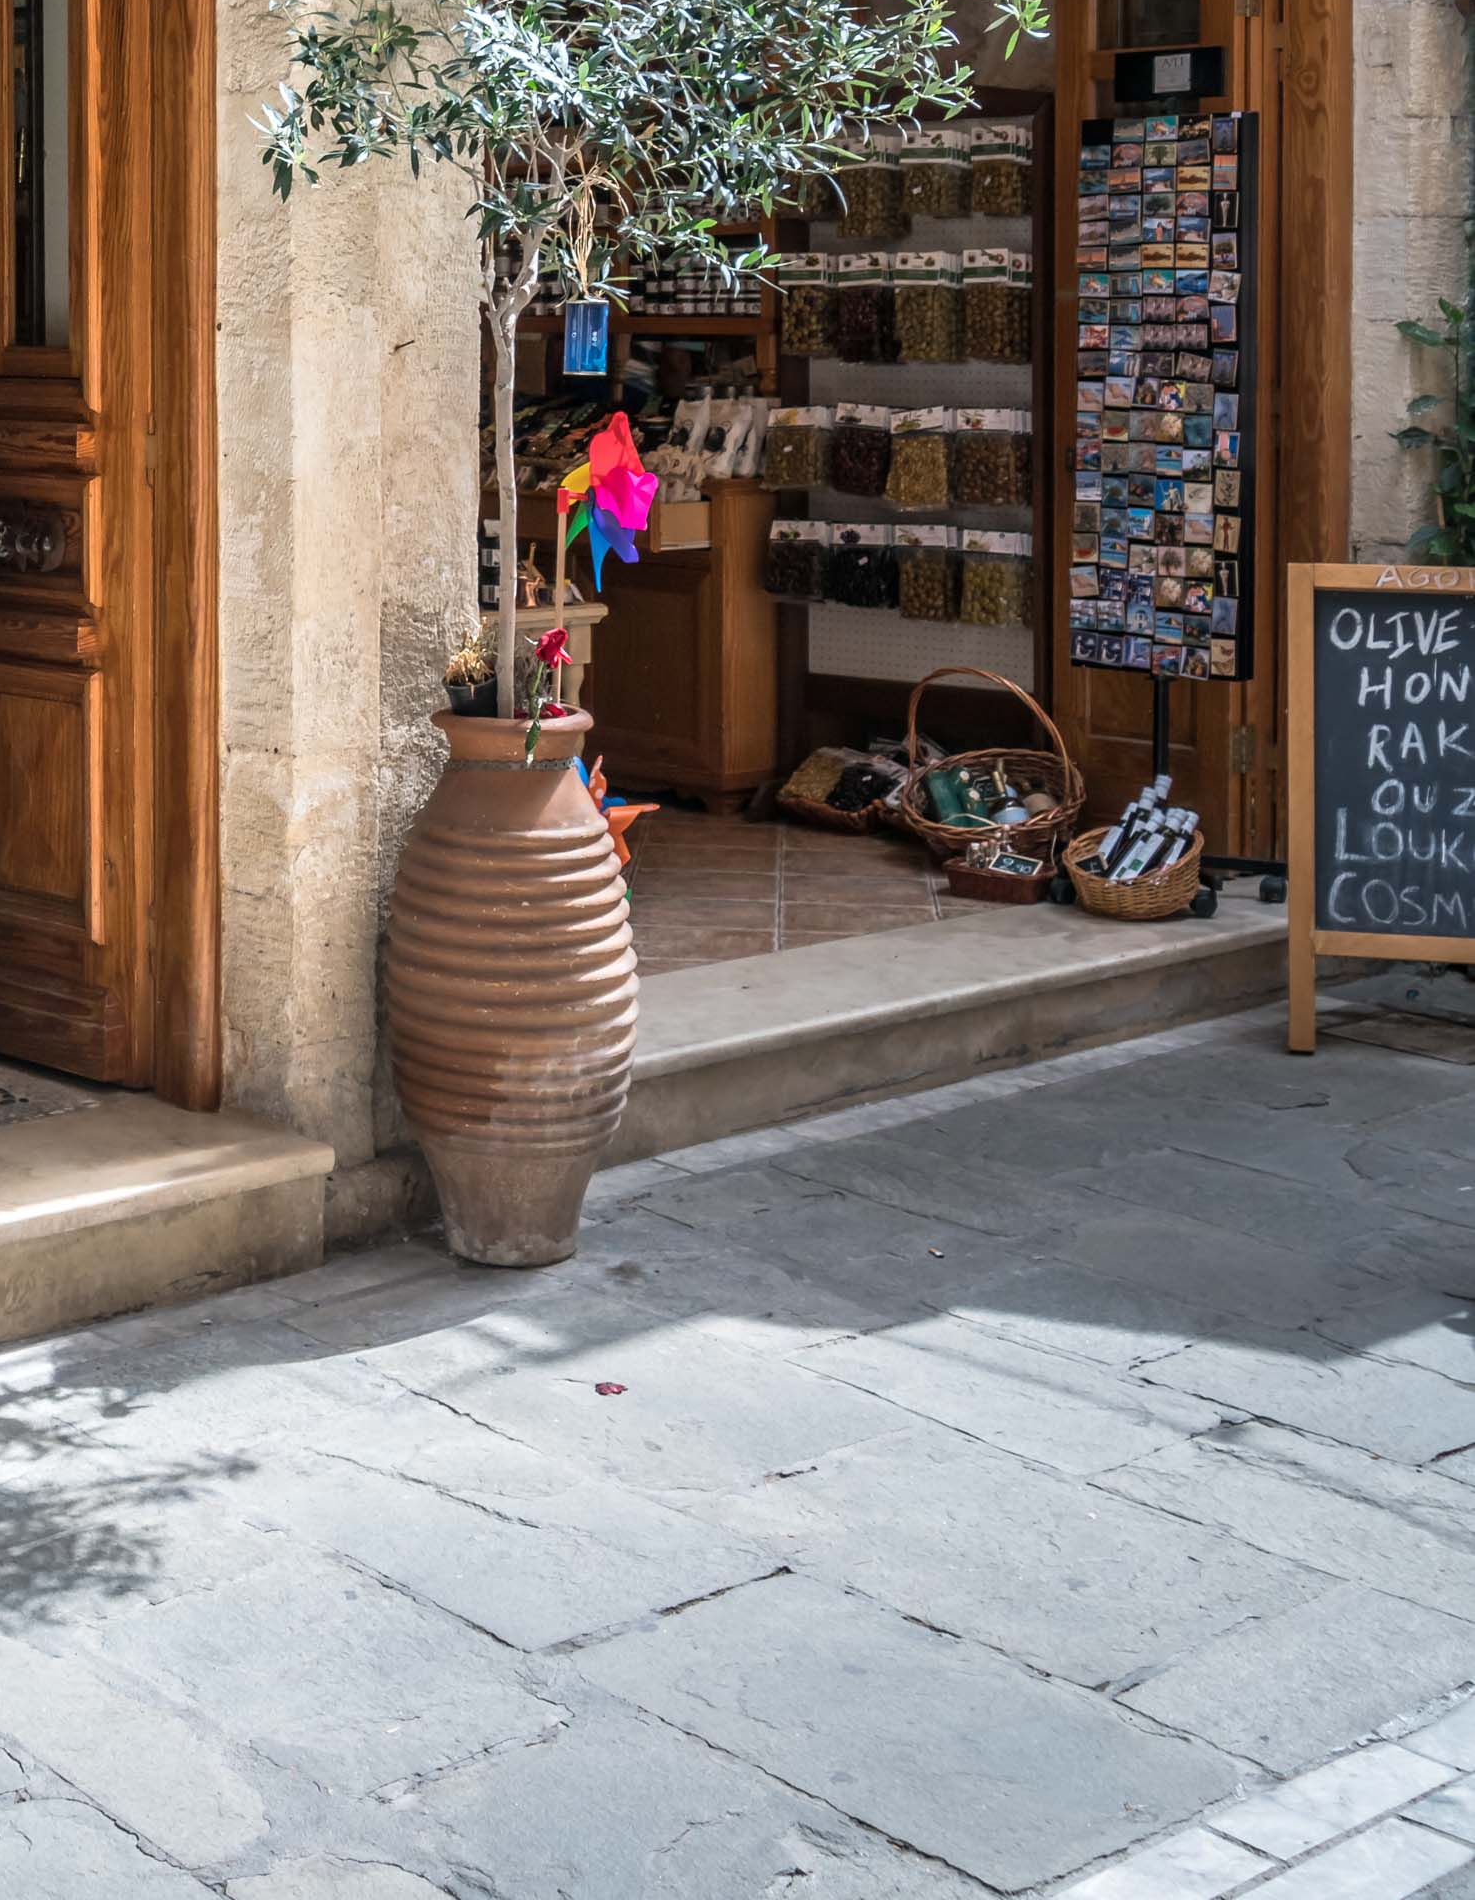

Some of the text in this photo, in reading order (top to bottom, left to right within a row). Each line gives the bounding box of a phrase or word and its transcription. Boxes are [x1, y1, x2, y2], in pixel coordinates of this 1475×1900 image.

[1330, 607, 1464, 659] OLIVE
[1357, 665, 1470, 710] HON
[1367, 718, 1475, 773] RAK
